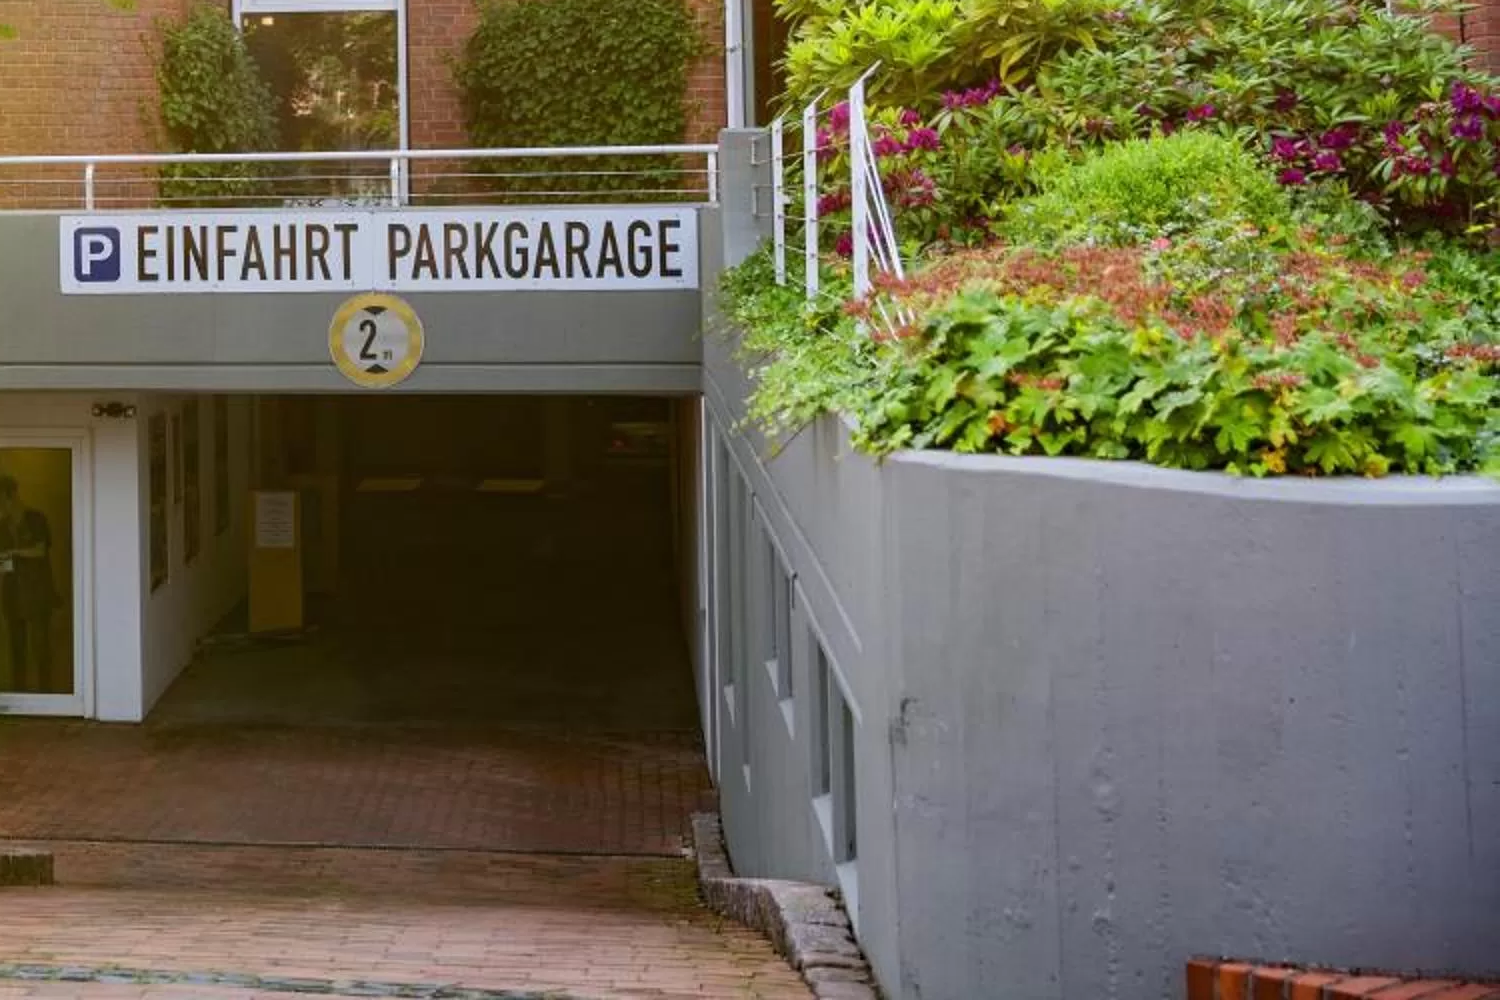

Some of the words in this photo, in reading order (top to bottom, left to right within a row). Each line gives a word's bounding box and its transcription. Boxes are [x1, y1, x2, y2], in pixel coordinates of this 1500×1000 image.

[82, 233, 114, 275] P
[136, 223, 359, 282] EINFAHRT
[388, 218, 684, 280] PARKGARAGE
[359, 318, 377, 361] 2
